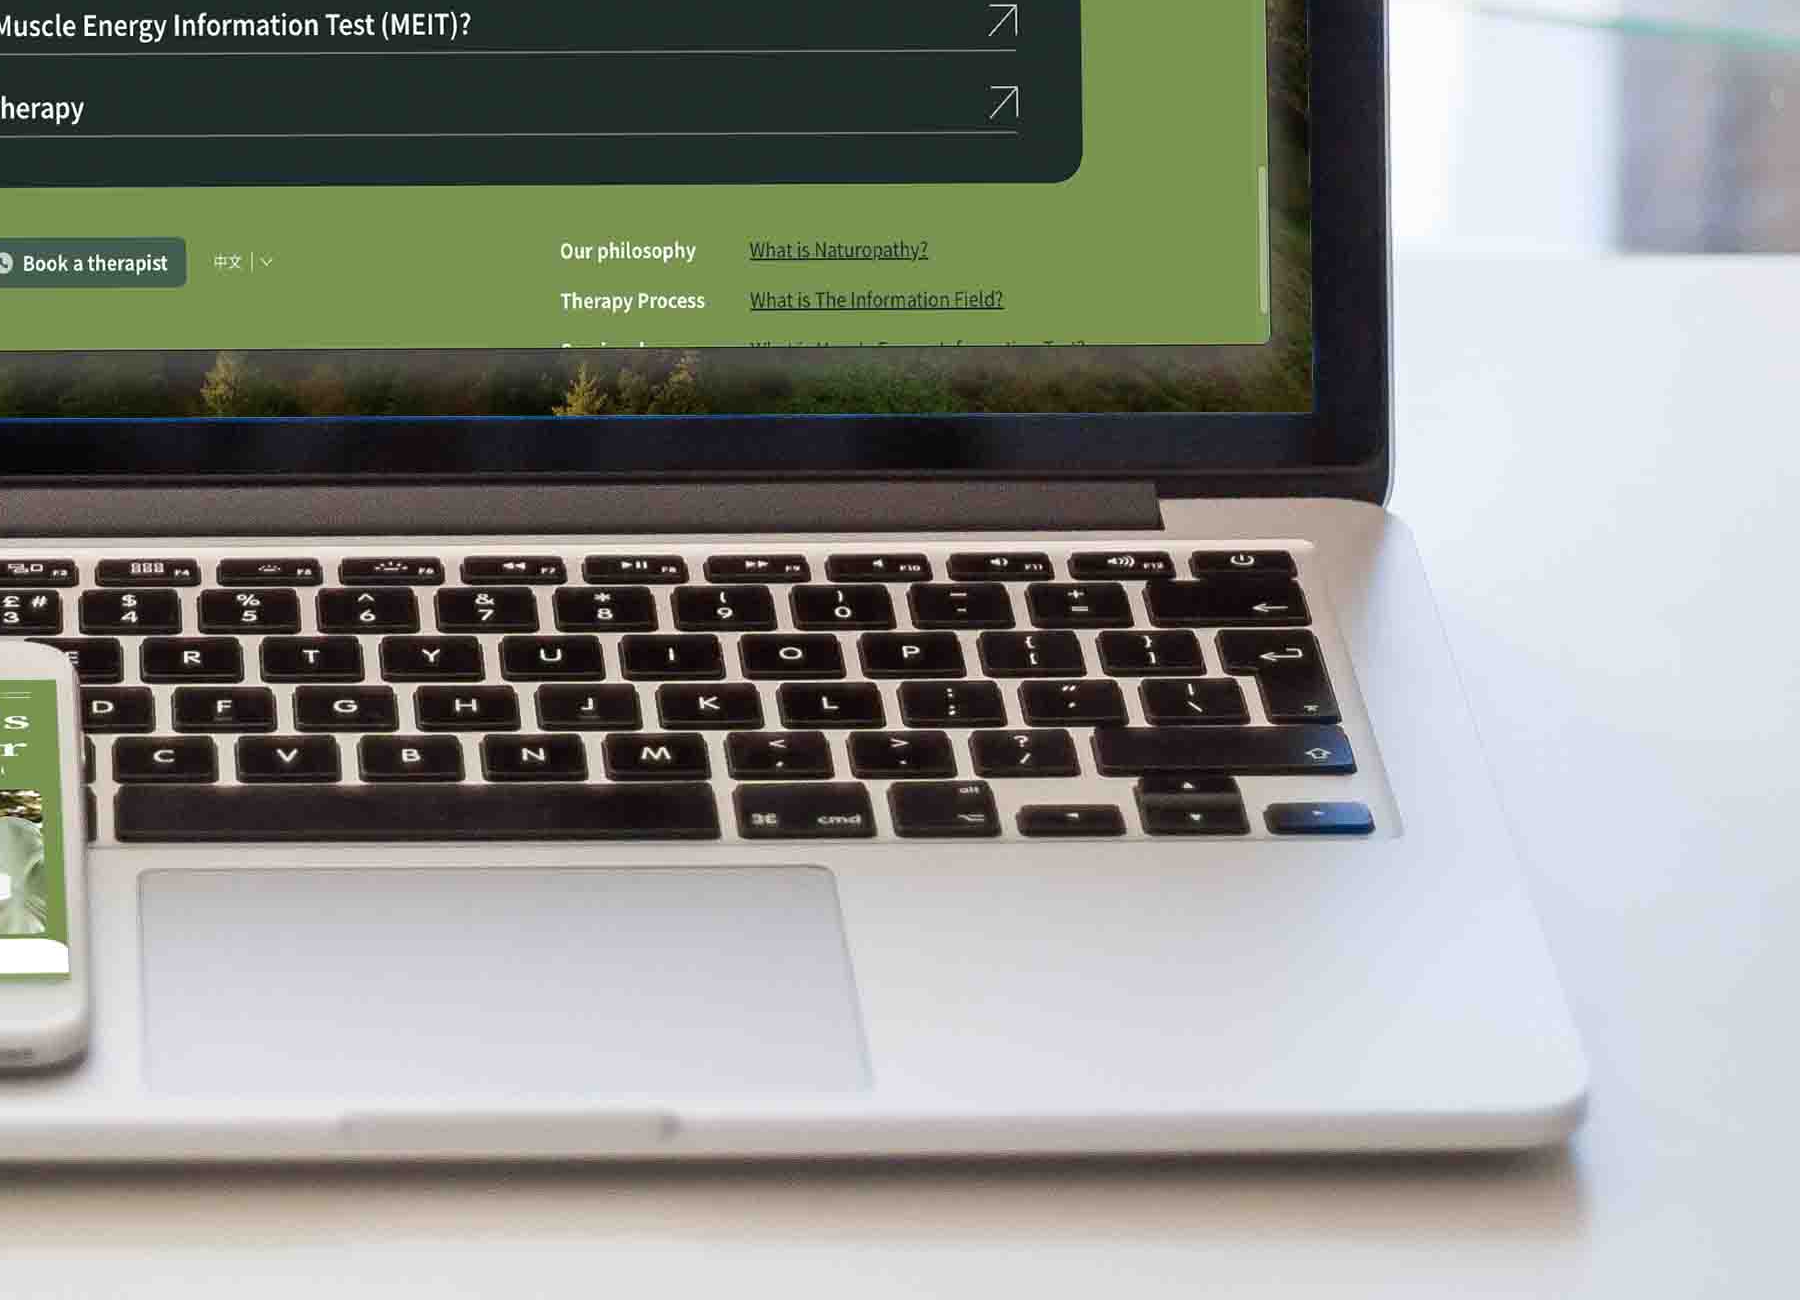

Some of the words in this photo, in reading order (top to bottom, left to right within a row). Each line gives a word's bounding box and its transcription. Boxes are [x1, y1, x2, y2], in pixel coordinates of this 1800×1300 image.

[83, 14, 168, 44] Energy
[174, 12, 319, 37] Information
[324, 13, 376, 36] Test
[381, 11, 471, 41] (MEIT)?
[560, 242, 593, 260] Our
[597, 240, 697, 264] philosophy
[749, 241, 793, 258] What
[797, 241, 811, 258] is
[815, 240, 929, 258] Naturopathy?
[23, 254, 69, 272] Book
[73, 258, 84, 272] a
[87, 253, 168, 276] therapist
[213, 253, 243, 269] 中文
[560, 291, 634, 314] Therapy
[638, 292, 705, 309] Process
[750, 291, 793, 307] What
[797, 291, 811, 307] is
[815, 291, 847, 307] The
[851, 290, 950, 307] Information
[954, 289, 1003, 307] Field?
[3, 611, 20, 624] 3
[121, 610, 138, 623] 4
[241, 610, 257, 622] 5
[359, 609, 376, 622] 6
[478, 608, 494, 621] 7
[597, 608, 614, 620] 8
[716, 607, 733, 619] 9
[183, 650, 201, 664] R
[302, 649, 320, 664] T
[421, 648, 441, 663] Y
[539, 648, 562, 662] U
[901, 645, 921, 659] P
[92, 700, 114, 714] D
[216, 699, 232, 713] F
[333, 699, 358, 713] G
[454, 698, 478, 712] H
[581, 697, 594, 711] J
[698, 696, 721, 710] K
[821, 696, 839, 710] L
[153, 749, 175, 763] C
[276, 748, 298, 763] V
[401, 748, 421, 763] B
[521, 747, 545, 761] N
[641, 746, 672, 760] M
[959, 786, 980, 794] alt
[817, 814, 862, 825] cmd
